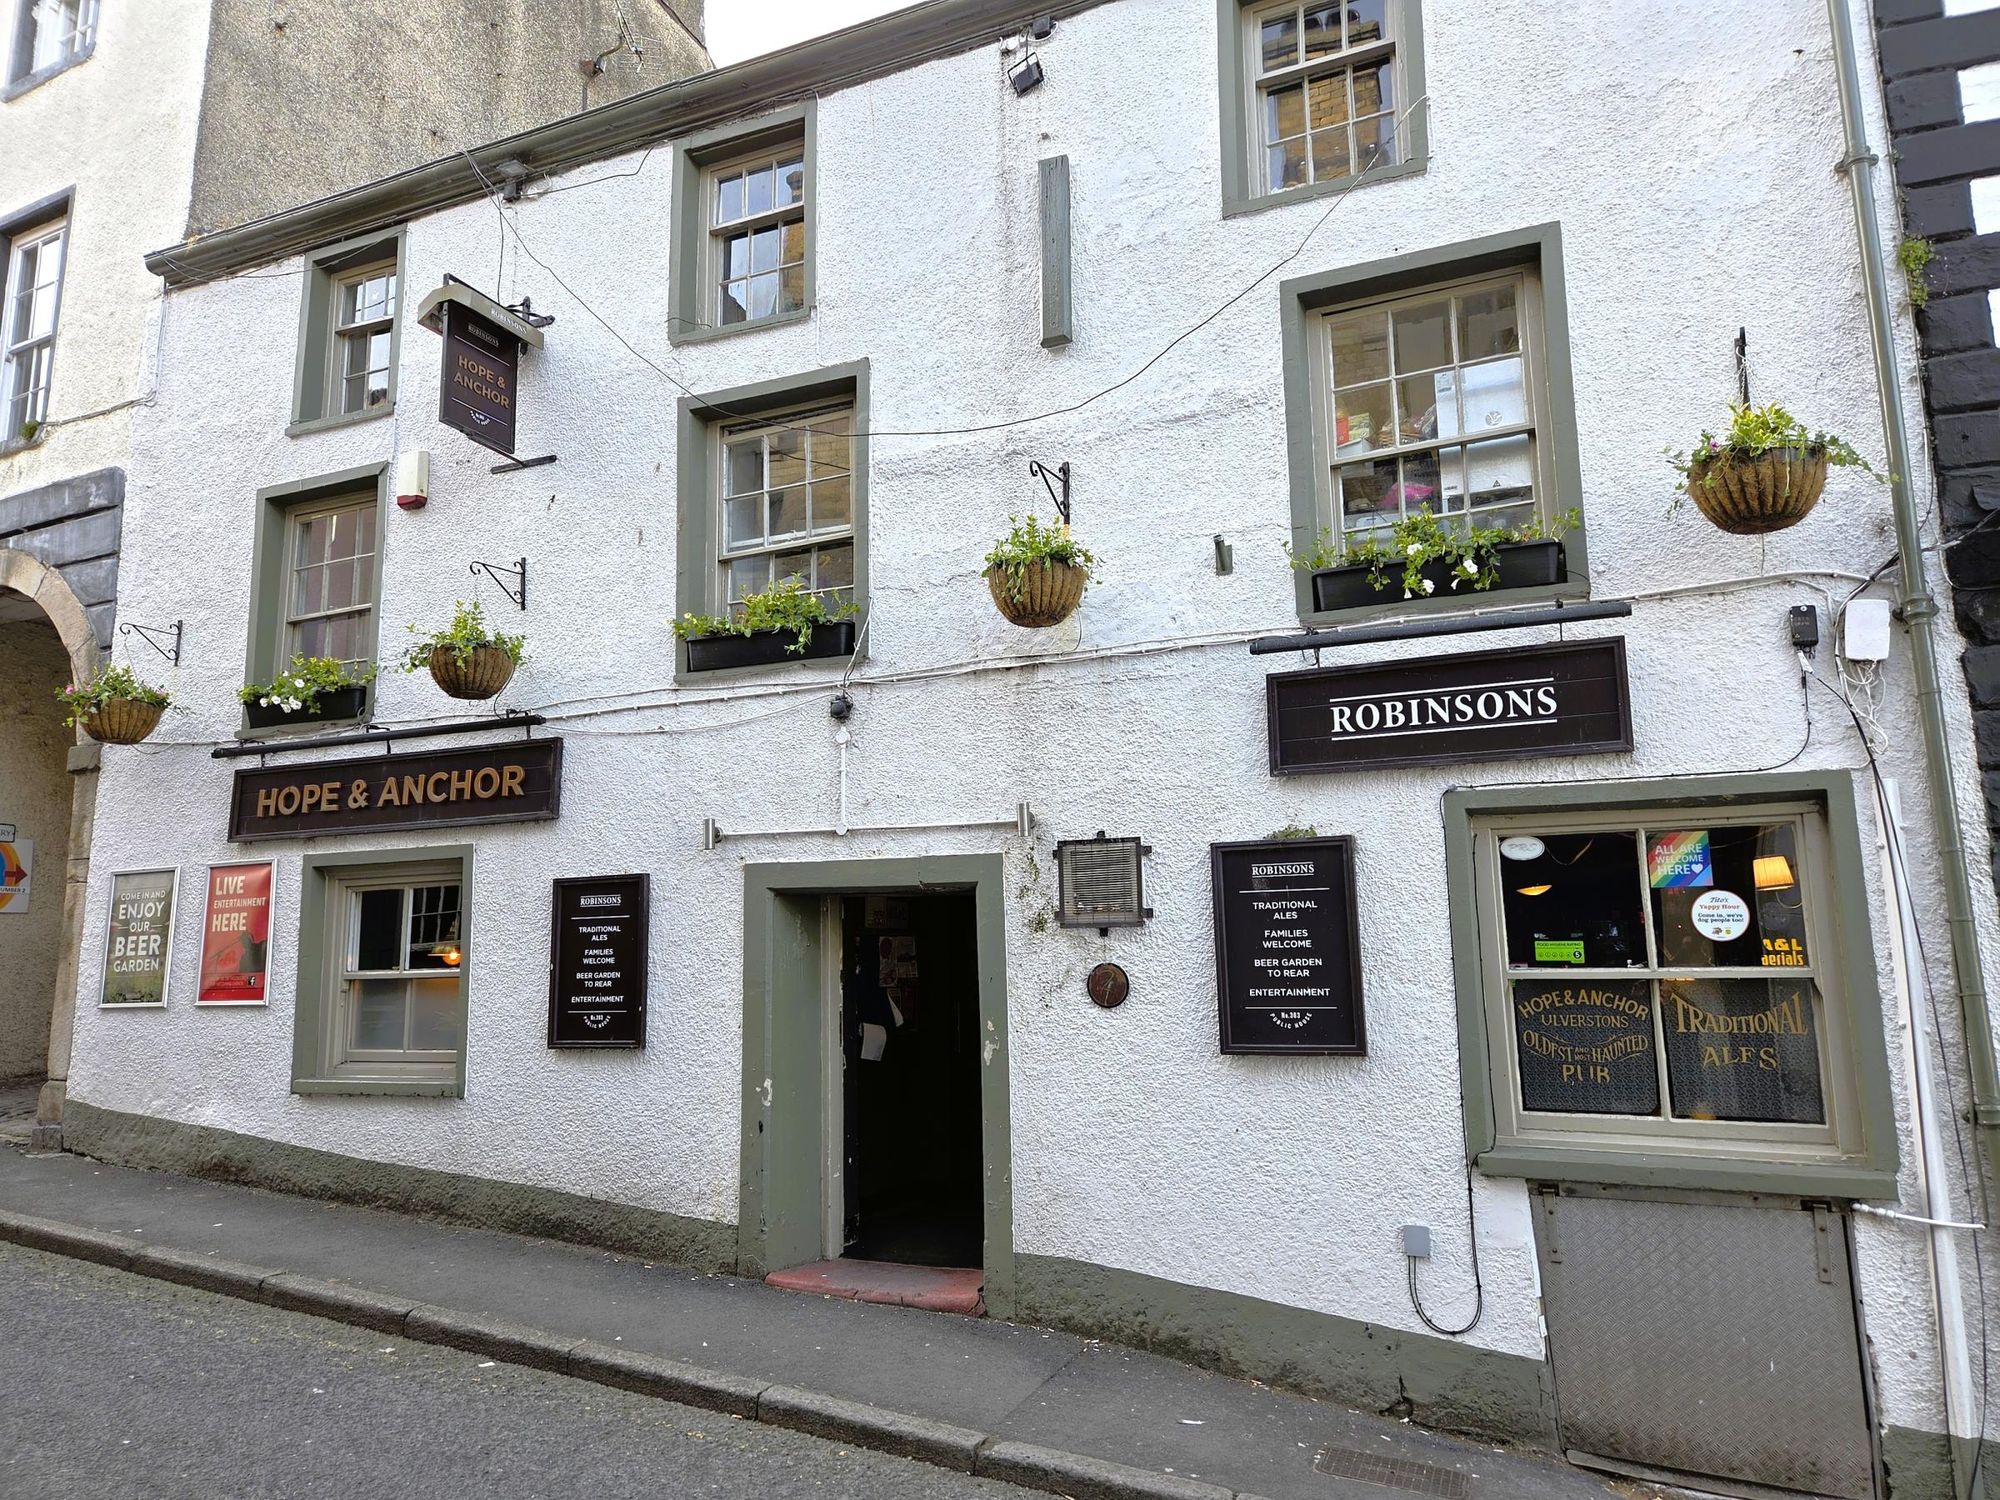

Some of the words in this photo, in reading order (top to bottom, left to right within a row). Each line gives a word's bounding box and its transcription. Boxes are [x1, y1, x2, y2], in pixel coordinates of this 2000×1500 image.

[468, 323, 499, 347] ROBINSONS
[458, 355, 494, 383] HOPE
[496, 376, 506, 388] &
[454, 372, 510, 409] ANCHOR
[1330, 686, 1557, 734] ROBINSONS
[257, 782, 342, 818] HOPE
[347, 779, 369, 809] &
[377, 765, 527, 807] ANCHOR
[1655, 845, 1675, 855] ALL
[1680, 843, 1703, 853] ARE
[1655, 855, 1704, 864] WELCOME
[1252, 864, 1315, 877] ROBINSONS
[1657, 864, 1691, 876] HERE
[216, 876, 246, 895] LIVE
[121, 892, 141, 901] COME
[142, 891, 149, 899] IN
[151, 890, 166, 899] AND
[580, 896, 622, 906] ROBINSONS
[214, 897, 266, 909] ENTERTAINMENT
[1252, 900, 1318, 910] TRADITIONAL
[118, 901, 165, 920] ENJOY
[1273, 912, 1298, 920] ALES
[129, 921, 150, 932] OUR
[212, 912, 247, 932] HERE
[579, 925, 621, 933] TRADITIONAL
[1264, 929, 1308, 938] FAMILIES
[115, 934, 161, 957] BEER
[1262, 940, 1312, 948] WELCOME
[584, 949, 614, 957] FAMILIES
[1575, 951, 1581, 959] 5
[1761, 952, 1804, 966] aerials
[113, 958, 160, 973] GARDEN
[582, 957, 616, 965] WELCOME
[1254, 959, 1279, 967] BEER
[1281, 958, 1323, 967] GARDEN
[576, 972, 593, 980] BEER
[1267, 969, 1281, 977] TO
[1283, 969, 1310, 977] REAR
[1249, 988, 1331, 997] ENTERTAINMENT
[571, 995, 624, 1003] ENTERTAINMENT
[1670, 991, 1808, 1036] TRADITIONAL
[1270, 1013, 1291, 1029] PUBLIC
[1294, 1012, 1312, 1028] HOUSE
[1541, 1014, 1629, 1028] ULVERSTONS
[1523, 1030, 1573, 1061] OLDEST
[1592, 1035, 1649, 1062] HAUNTED
[1703, 1046, 1778, 1071] ALES
[1562, 1064, 1610, 1083] PUB
